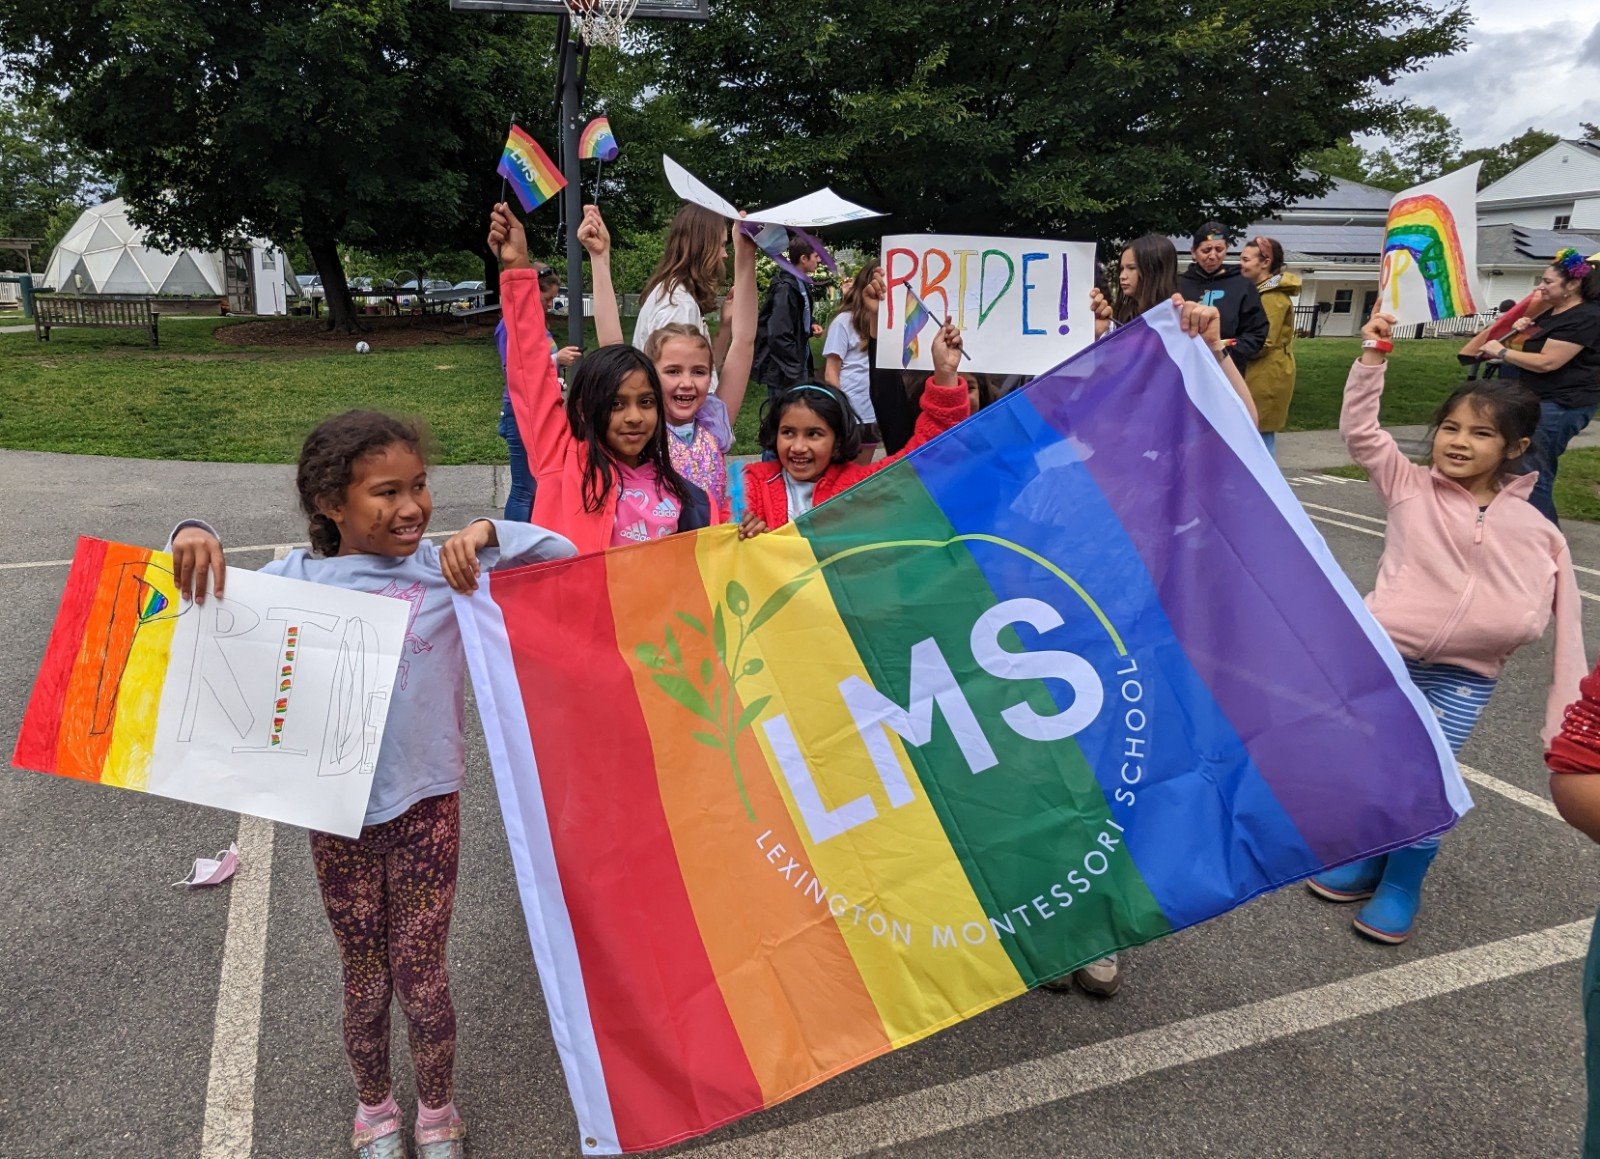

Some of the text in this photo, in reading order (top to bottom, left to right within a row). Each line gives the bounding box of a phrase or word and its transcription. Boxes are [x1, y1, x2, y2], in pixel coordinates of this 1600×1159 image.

[510, 148, 540, 183] LMS
[885, 247, 1070, 335] PRIDE!
[755, 659, 1147, 949] LEXINGTON MONTESSORI SCHOOL
[762, 597, 1104, 845] LMS
